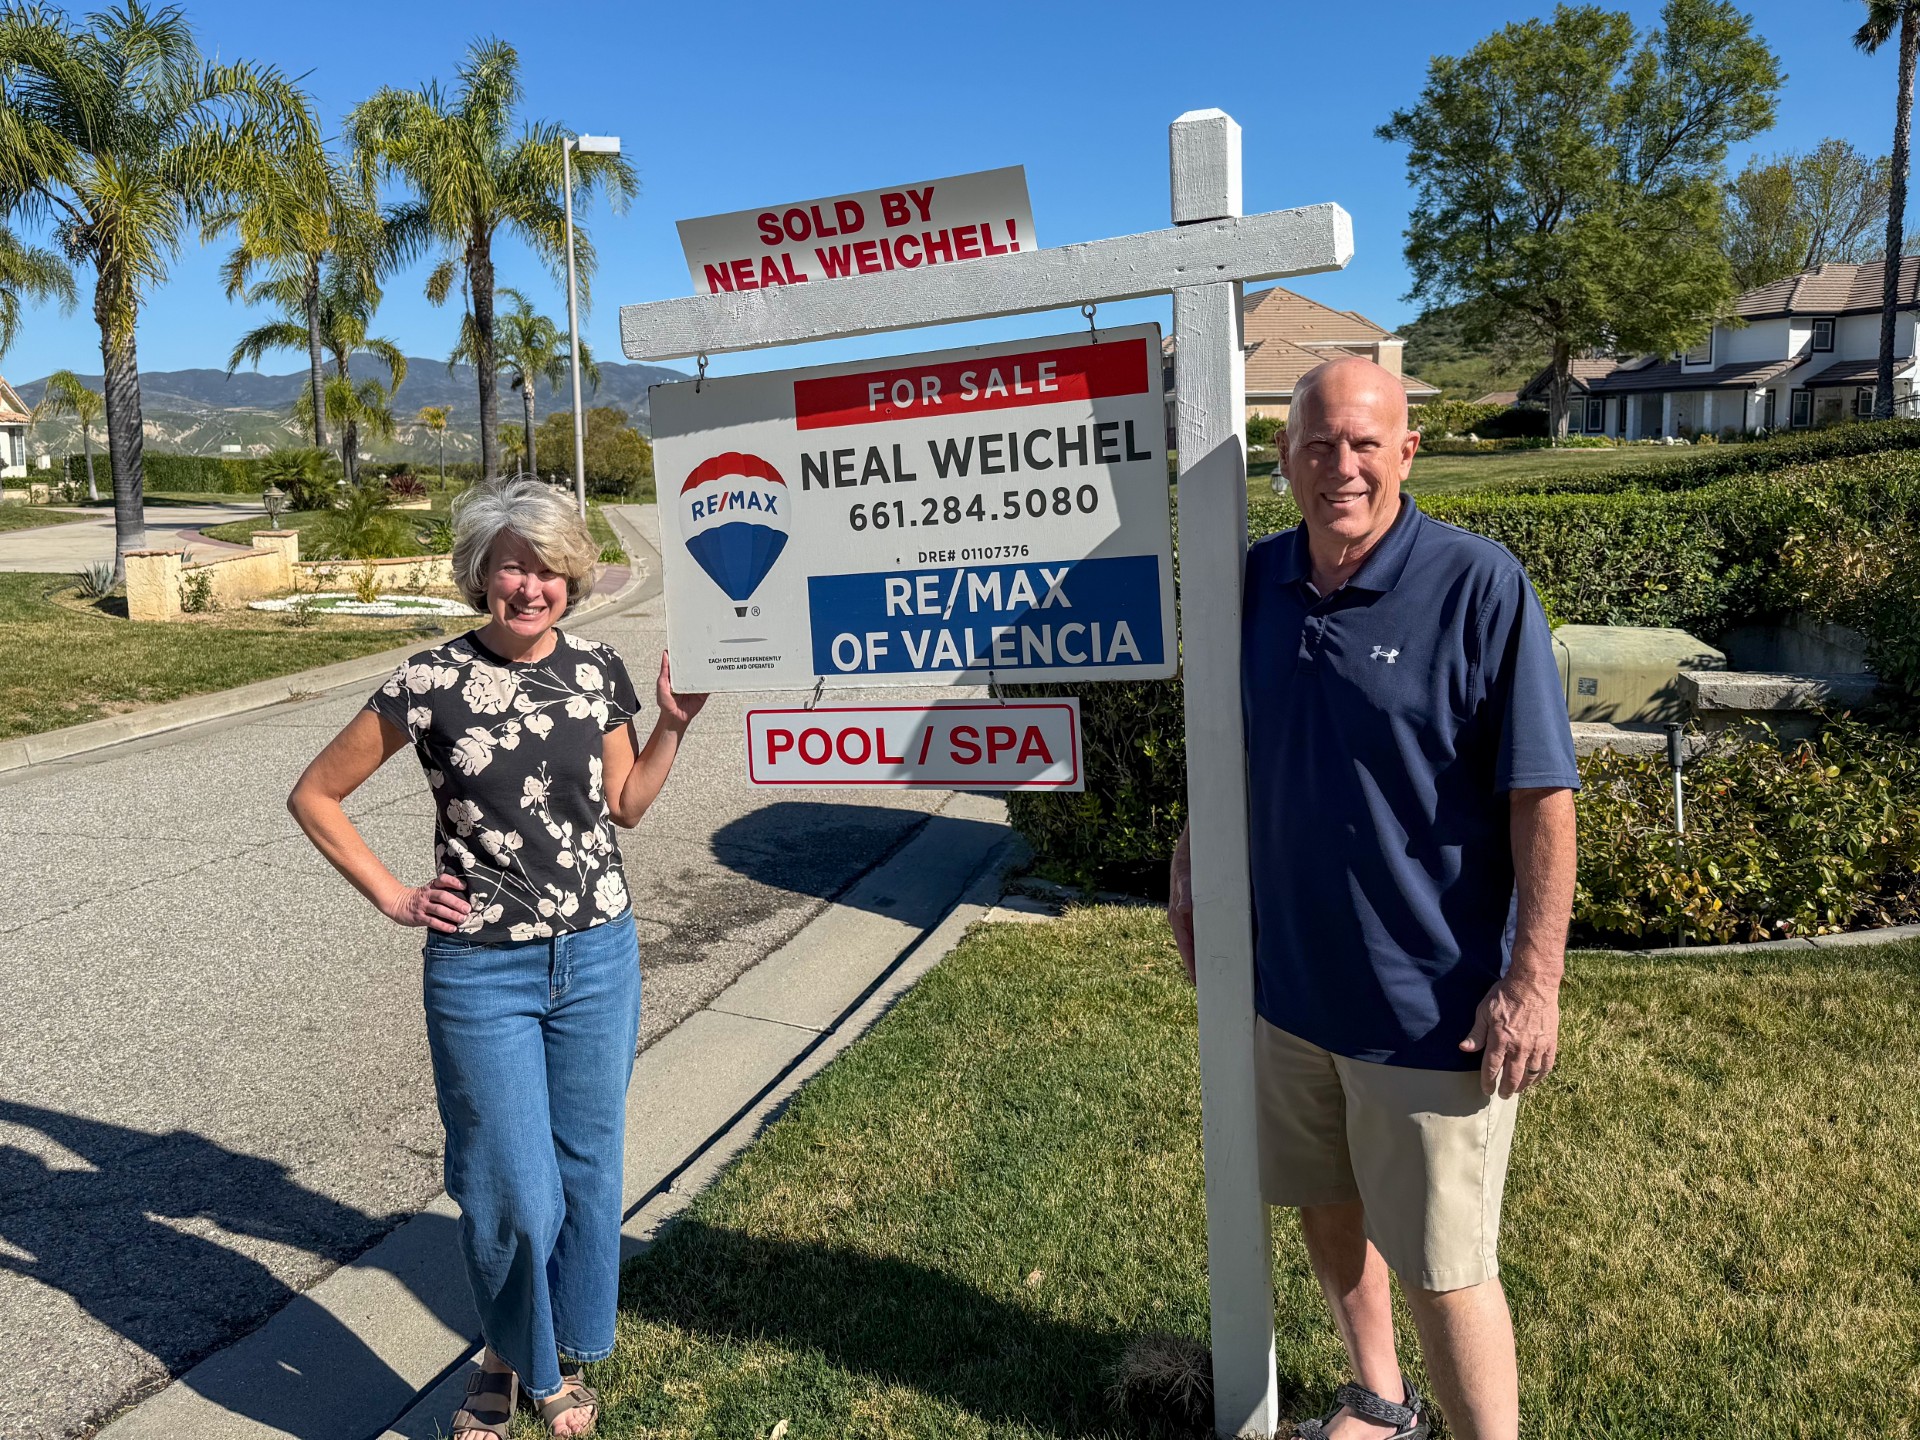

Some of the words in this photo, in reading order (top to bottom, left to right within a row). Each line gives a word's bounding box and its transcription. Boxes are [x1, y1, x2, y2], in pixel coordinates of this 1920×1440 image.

[759, 200, 864, 245] SOLD
[881, 186, 935, 227] BY
[705, 258, 807, 293] NEAL
[816, 219, 1020, 278] WEICHEL!
[869, 376, 943, 412] FOR
[961, 361, 1060, 400] SALE
[801, 443, 917, 491] NEAL
[928, 419, 1152, 478] WEICHEL
[691, 489, 778, 522] RE/MAX
[850, 484, 1099, 532] 661.284.5080
[919, 549, 956, 563] DRE#
[961, 545, 1029, 560] 01107376
[886, 567, 1072, 620] RE/MAX
[832, 632, 889, 671] OF
[901, 621, 1142, 668] VALENCIA
[767, 727, 904, 766] POOL
[919, 726, 933, 765] /
[950, 725, 1054, 765] SPA
